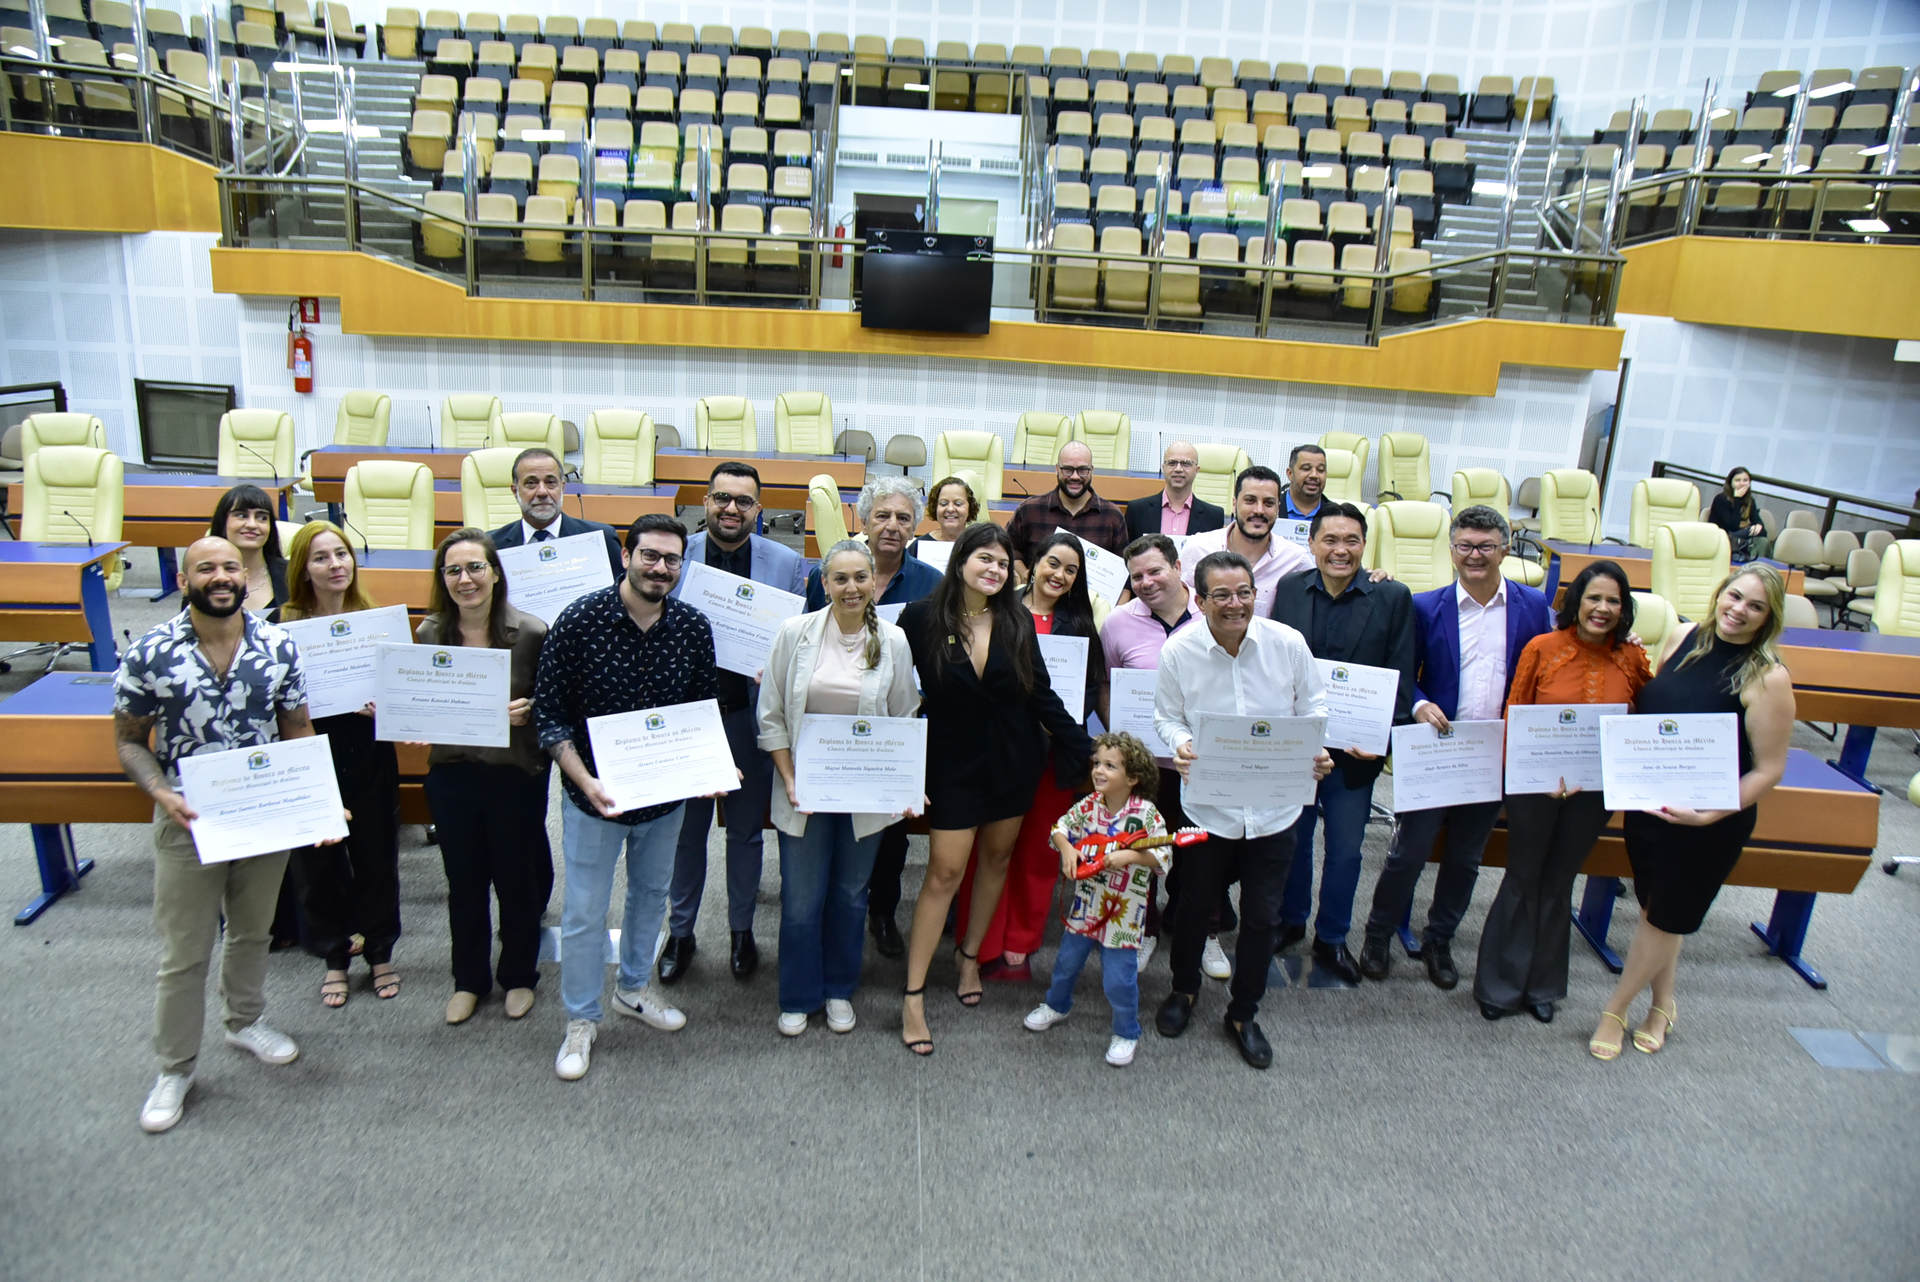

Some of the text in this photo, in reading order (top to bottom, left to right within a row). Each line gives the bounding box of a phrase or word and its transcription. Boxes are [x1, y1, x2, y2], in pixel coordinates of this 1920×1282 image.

[336, 639, 357, 647] Honra
[323, 663, 371, 675] Fernanda Meireles
[398, 668, 425, 676] Diploma
[1332, 683, 1350, 691] Honra
[614, 736, 642, 746] Diploma
[651, 731, 671, 740] Honra
[680, 726, 702, 735] Mérito
[884, 739, 905, 747] Mérito
